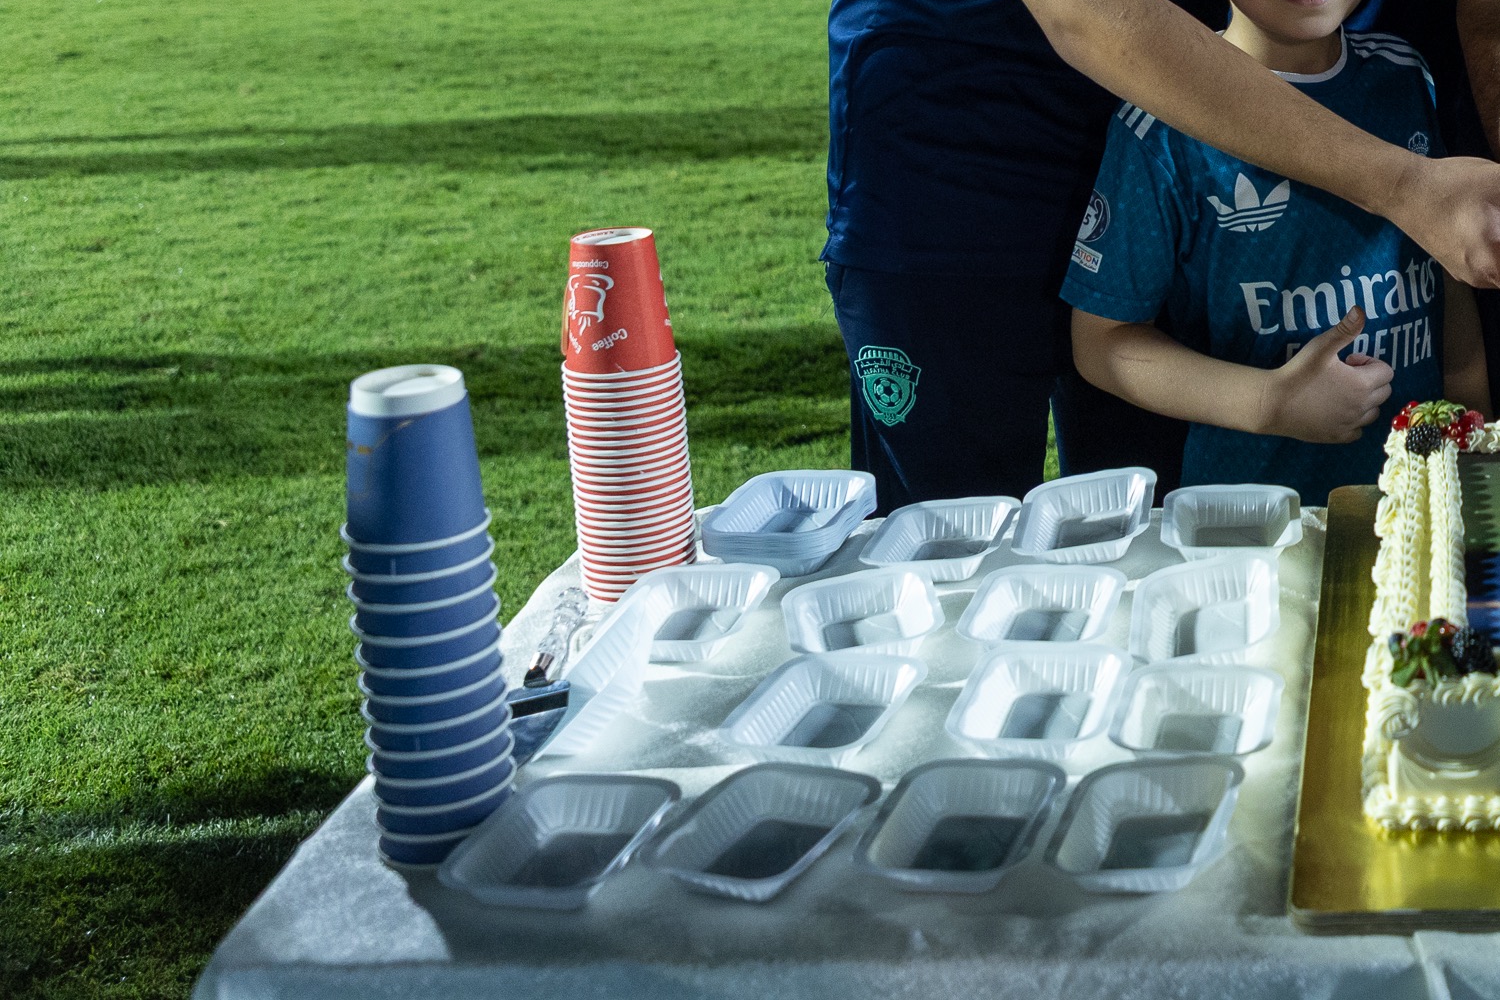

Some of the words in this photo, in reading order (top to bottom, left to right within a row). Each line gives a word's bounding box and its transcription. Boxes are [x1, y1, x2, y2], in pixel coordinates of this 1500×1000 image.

[1239, 257, 1437, 336] Emirates
[591, 328, 628, 351] Coffee
[891, 370, 911, 381] CLUB
